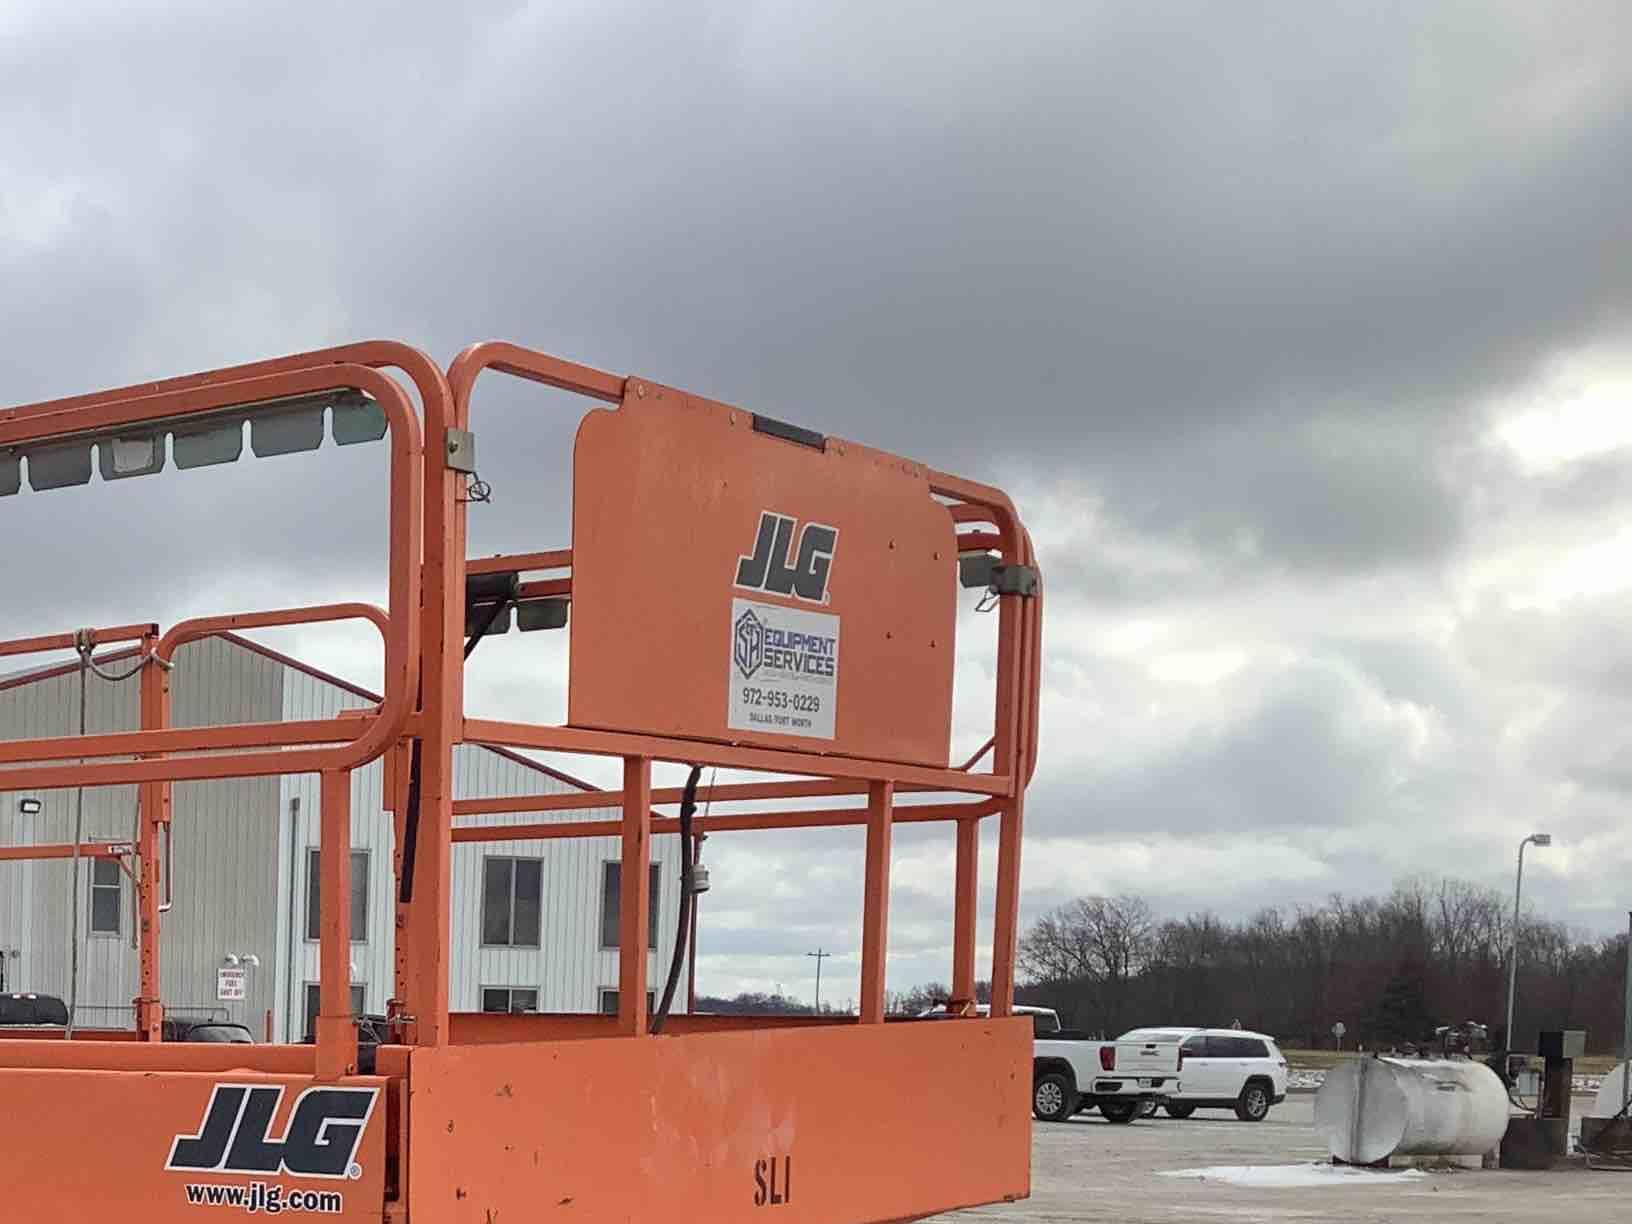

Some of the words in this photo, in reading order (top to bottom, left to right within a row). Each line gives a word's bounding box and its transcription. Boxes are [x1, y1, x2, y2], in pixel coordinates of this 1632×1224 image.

[733, 510, 839, 602] JLG
[764, 627, 835, 655] EQUIPMENT
[763, 647, 834, 677] SERVICES
[165, 1083, 380, 1179] JLG
[186, 1182, 342, 1212] www.jlg.com
